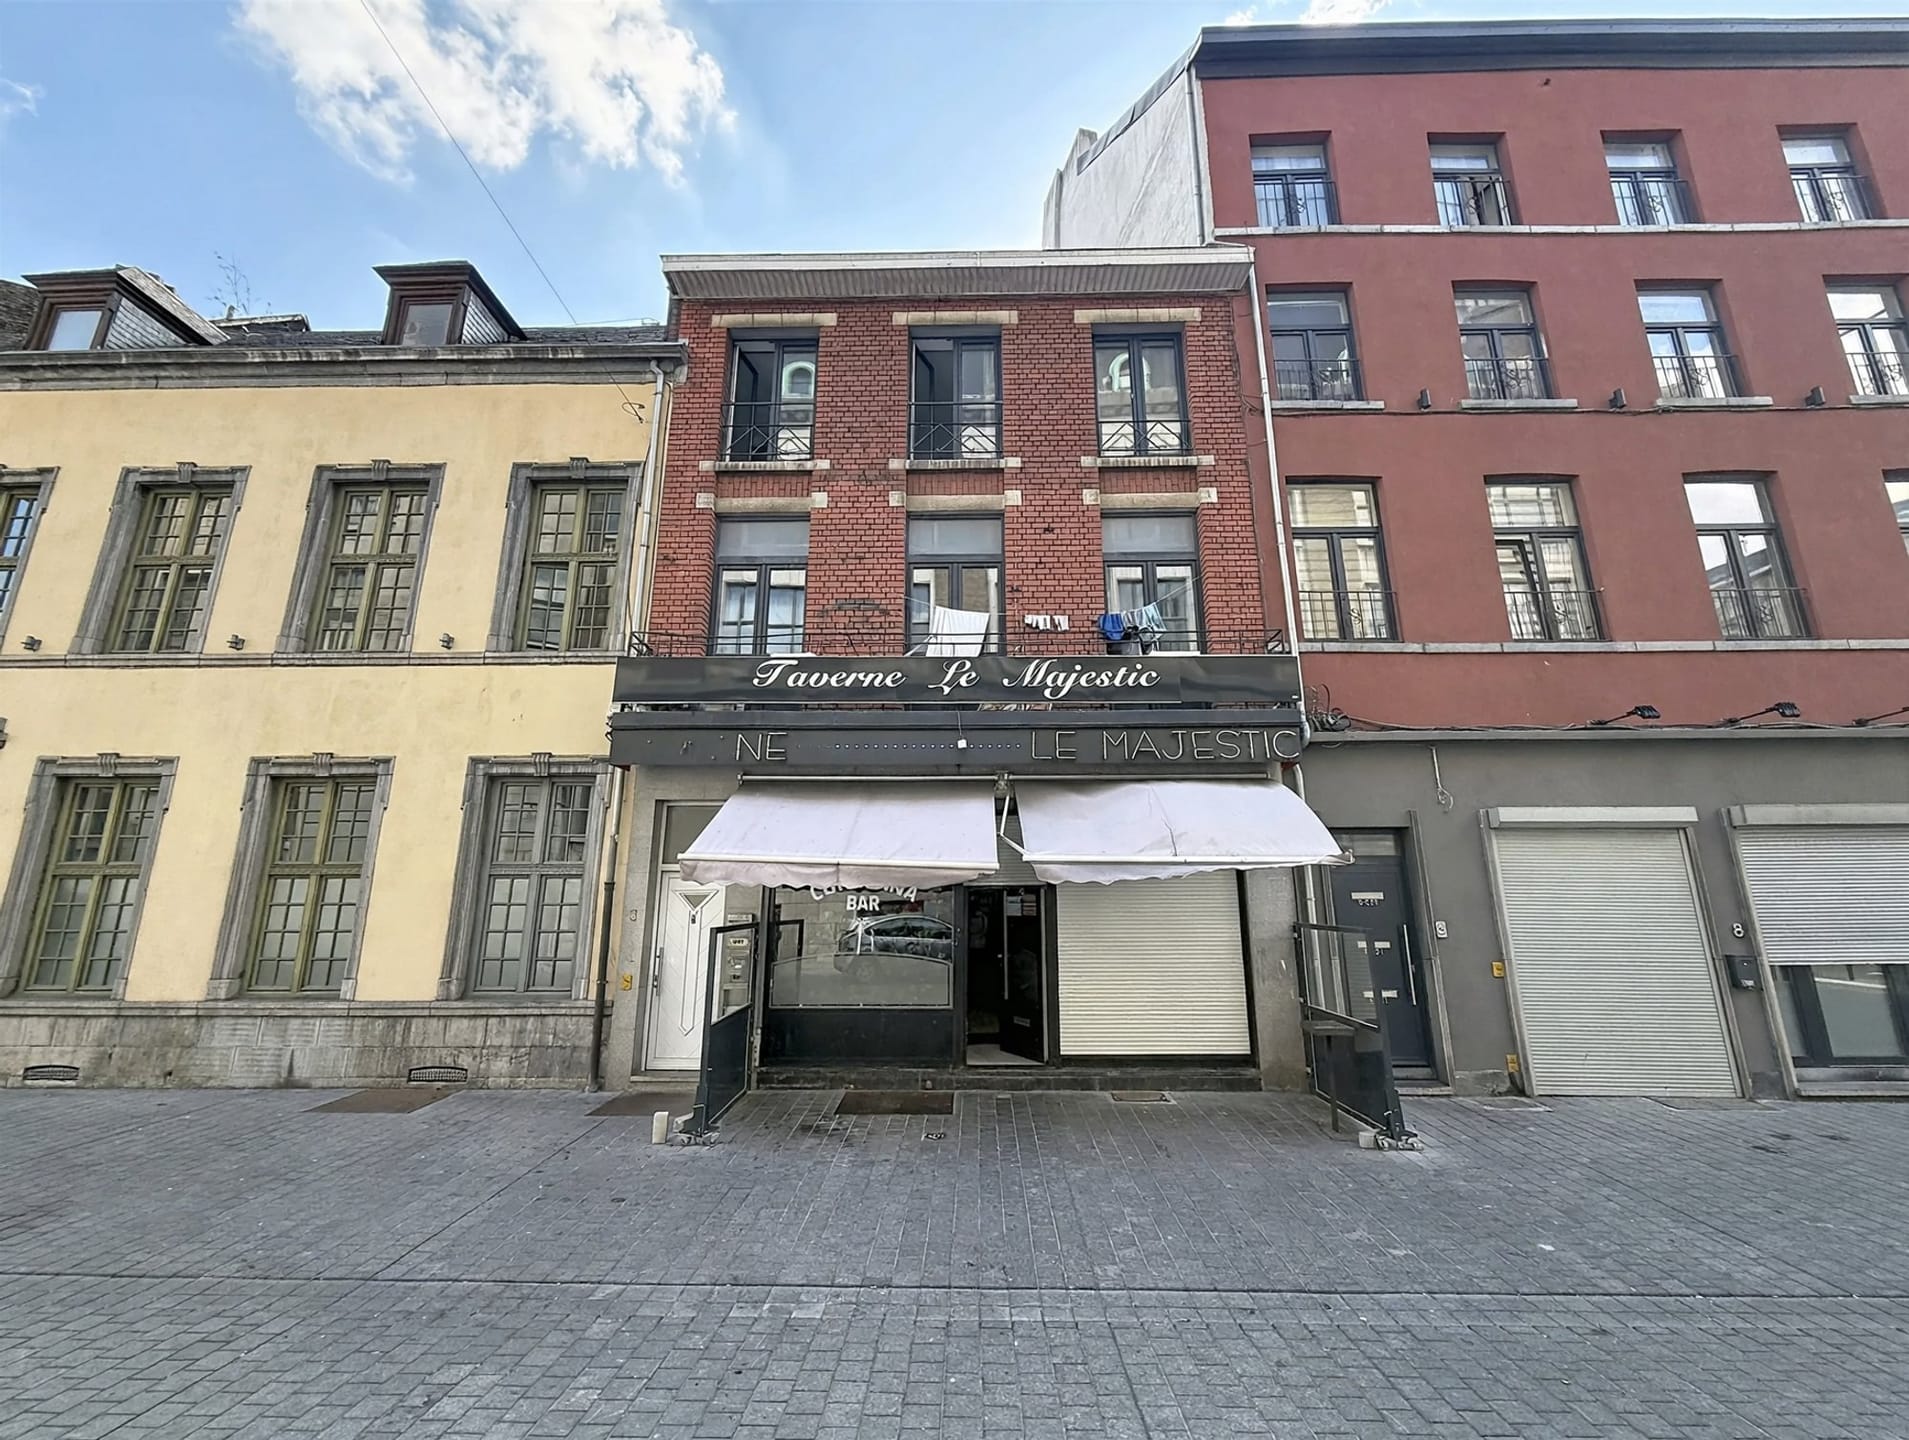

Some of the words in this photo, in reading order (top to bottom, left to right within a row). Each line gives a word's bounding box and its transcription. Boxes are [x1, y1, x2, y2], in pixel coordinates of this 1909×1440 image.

[752, 659, 907, 688] Taverne
[927, 660, 978, 696] Le
[1002, 659, 1161, 700] Majestic
[735, 732, 788, 761] NE
[1031, 731, 1078, 760] LE
[1102, 730, 1300, 760] MAJESTIC
[846, 894, 881, 912] BAR
[1733, 923, 1744, 938] 8
